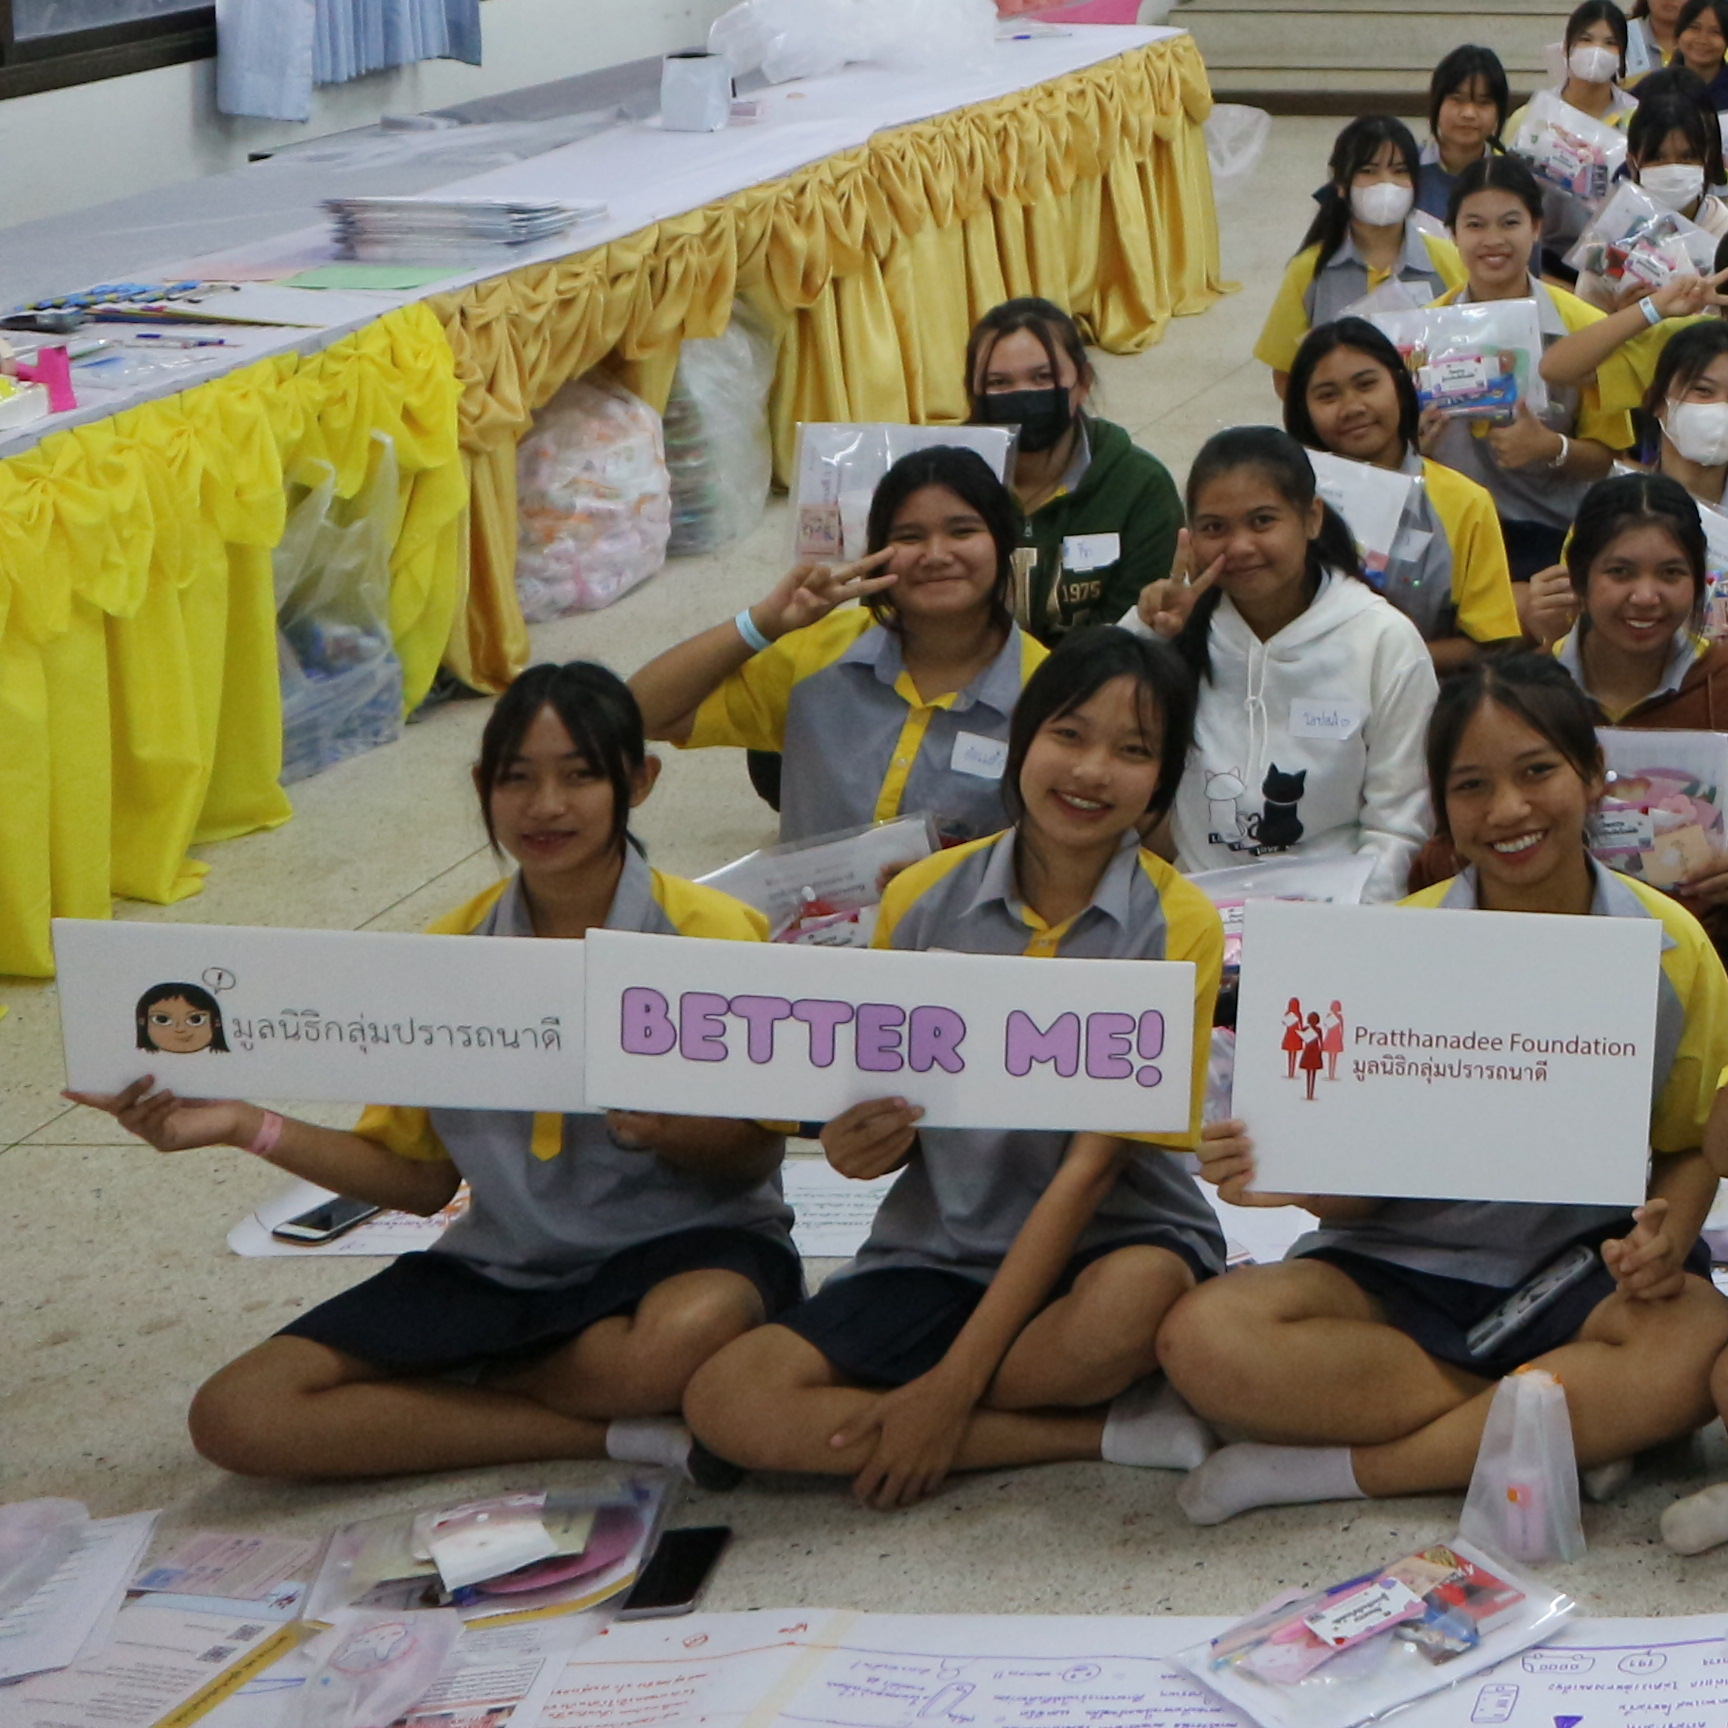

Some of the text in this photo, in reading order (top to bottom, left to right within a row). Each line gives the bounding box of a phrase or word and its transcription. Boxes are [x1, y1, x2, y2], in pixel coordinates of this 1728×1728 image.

[1061, 580, 1102, 603] 1975
[231, 1009, 562, 1059] มูลนิธิกลุ่มปรารถนาดี
[620, 985, 1165, 1089] BETTER ME!
[1354, 1026, 1637, 1057] Pratthanadee Foundation
[1352, 1054, 1548, 1085] มูลนิธิกลุ่มปรารถนาดี
